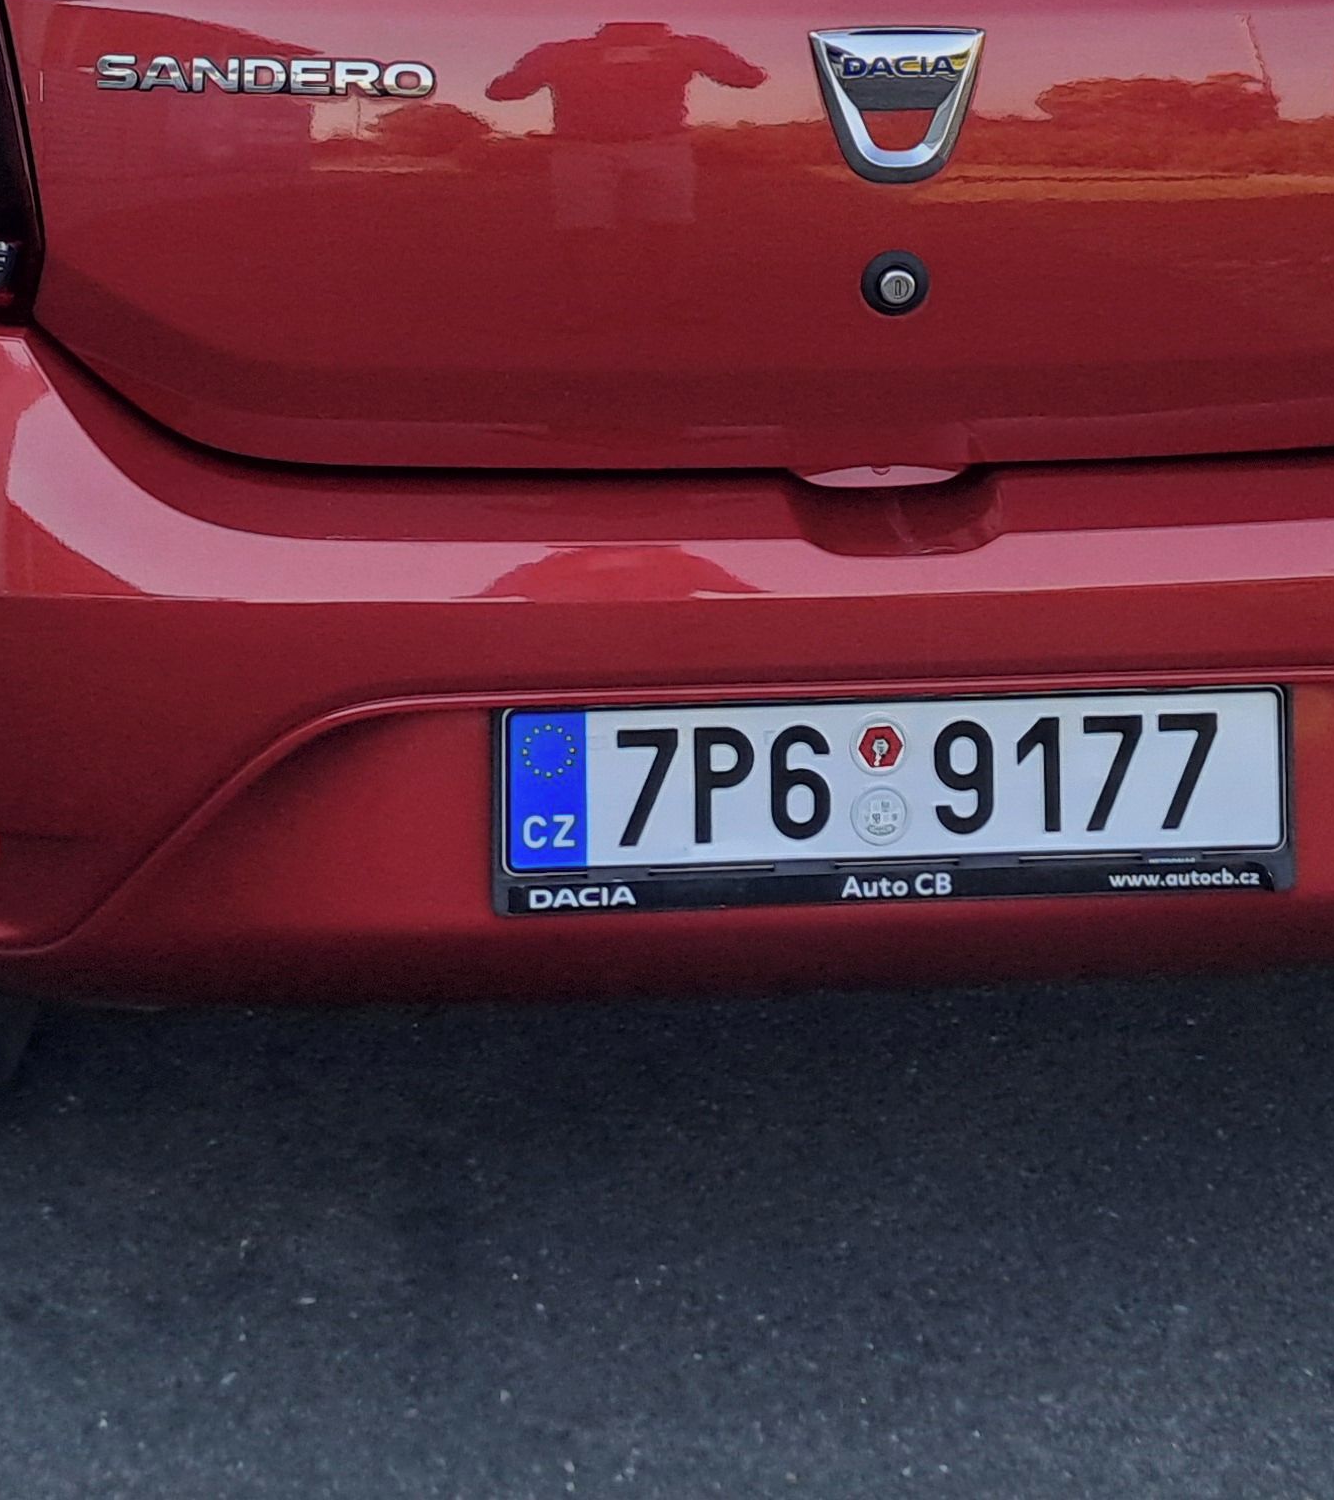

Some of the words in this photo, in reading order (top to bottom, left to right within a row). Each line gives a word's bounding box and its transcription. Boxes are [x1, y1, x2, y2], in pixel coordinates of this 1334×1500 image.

[96, 54, 436, 97] SANDERO
[842, 55, 956, 77] DACIA
[616, 724, 831, 847] 7P6
[933, 712, 1218, 835] 9177
[522, 814, 577, 849] CZ
[840, 876, 909, 899] Auto
[914, 872, 953, 896] CB
[1108, 867, 1261, 887] www.autocb.cz
[528, 886, 637, 910] DACIA
